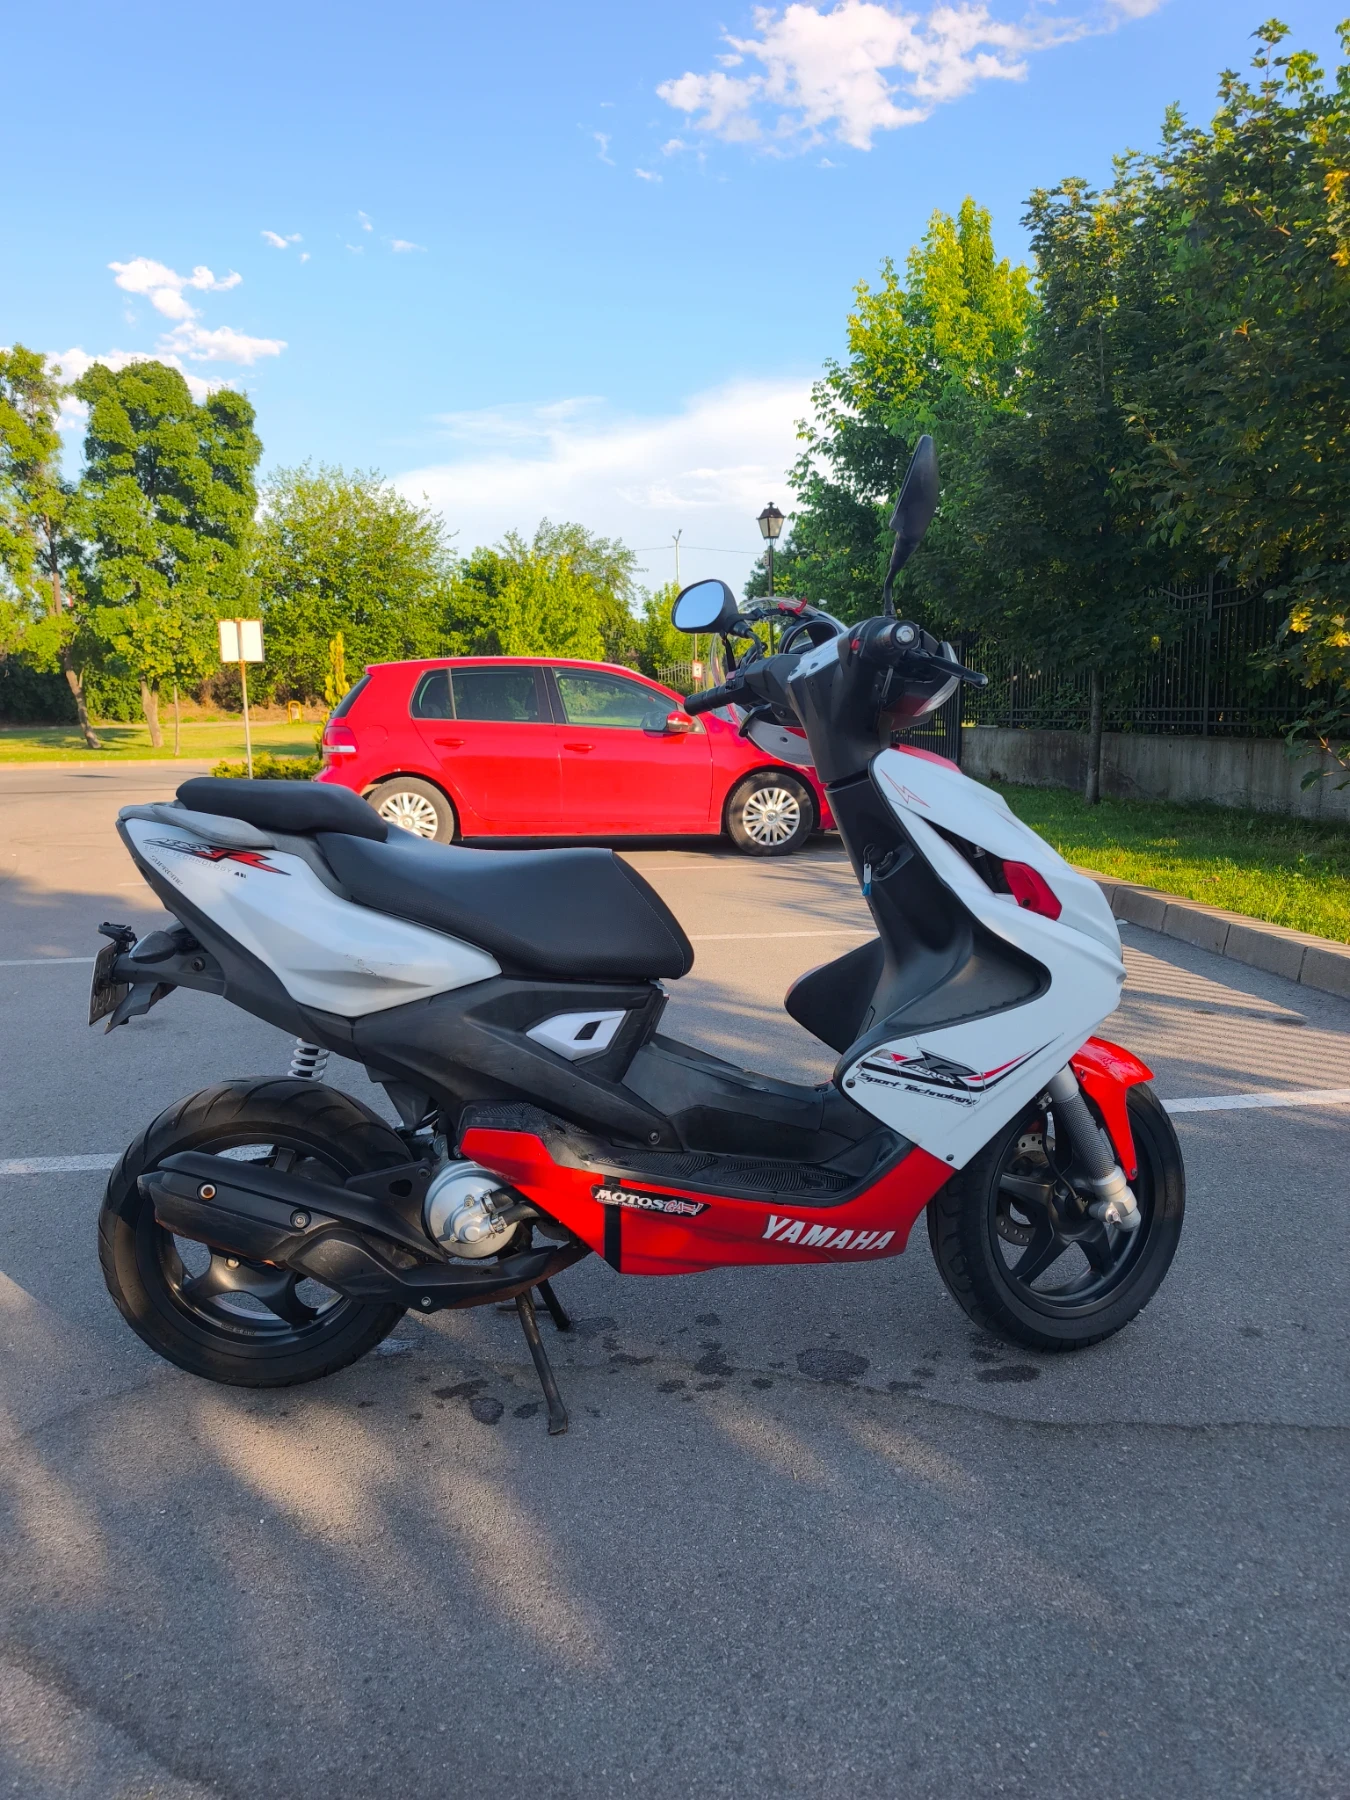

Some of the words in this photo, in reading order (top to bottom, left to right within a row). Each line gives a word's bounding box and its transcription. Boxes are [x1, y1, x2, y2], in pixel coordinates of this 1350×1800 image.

[144, 845, 170, 856] SPORT
[172, 851, 232, 874] TECHNOLOGY
[901, 1064, 960, 1085] AEROX
[860, 1073, 901, 1087] Sport
[904, 1083, 976, 1106] Technology
[595, 1189, 664, 1209] MOTOS
[762, 1214, 896, 1251] YAMAHA
